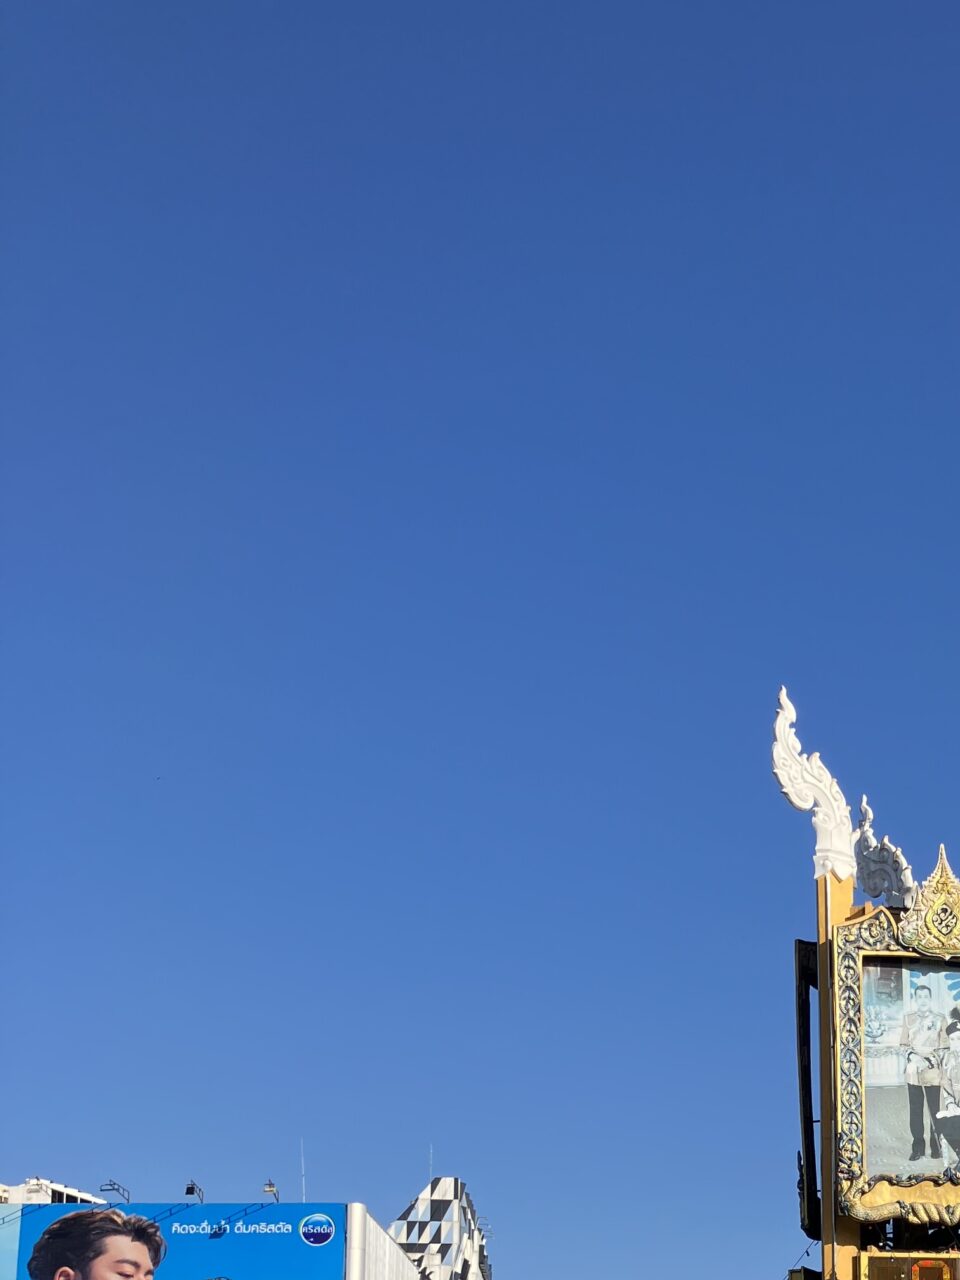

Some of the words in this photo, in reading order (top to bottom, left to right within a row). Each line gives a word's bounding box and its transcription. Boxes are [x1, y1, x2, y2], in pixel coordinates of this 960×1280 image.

[234, 1219, 292, 1234] ดื่มคริสตัล
